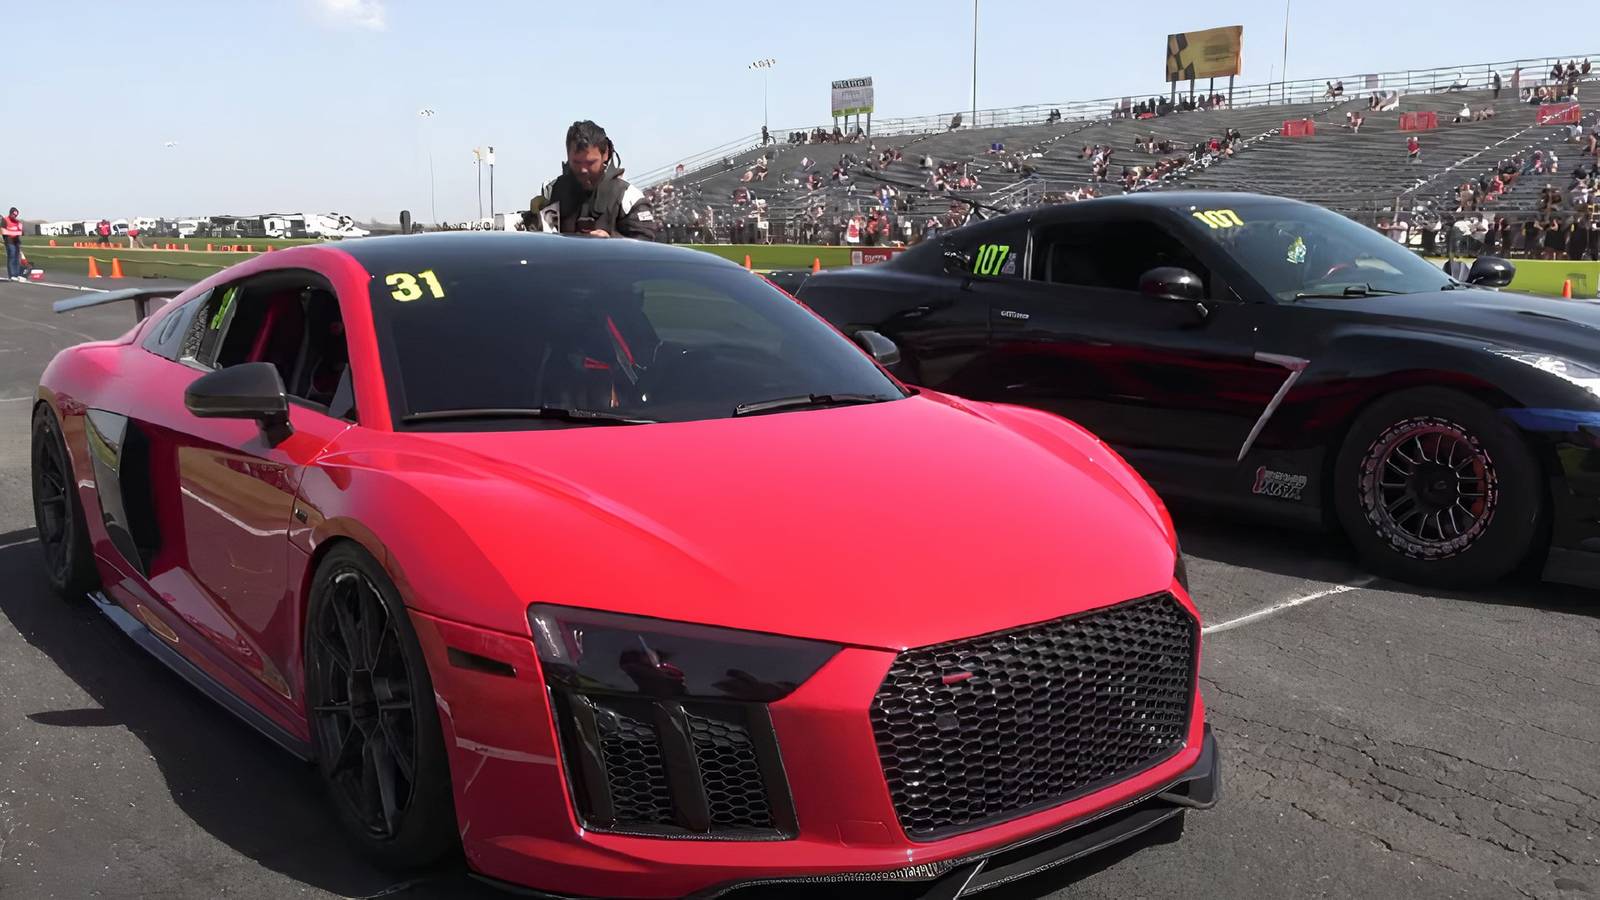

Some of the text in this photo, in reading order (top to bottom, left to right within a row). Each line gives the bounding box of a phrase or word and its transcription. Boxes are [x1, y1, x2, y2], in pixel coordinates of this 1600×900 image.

[1192, 209, 1244, 229] 107
[973, 244, 1010, 276] 107
[385, 269, 445, 302] 31
